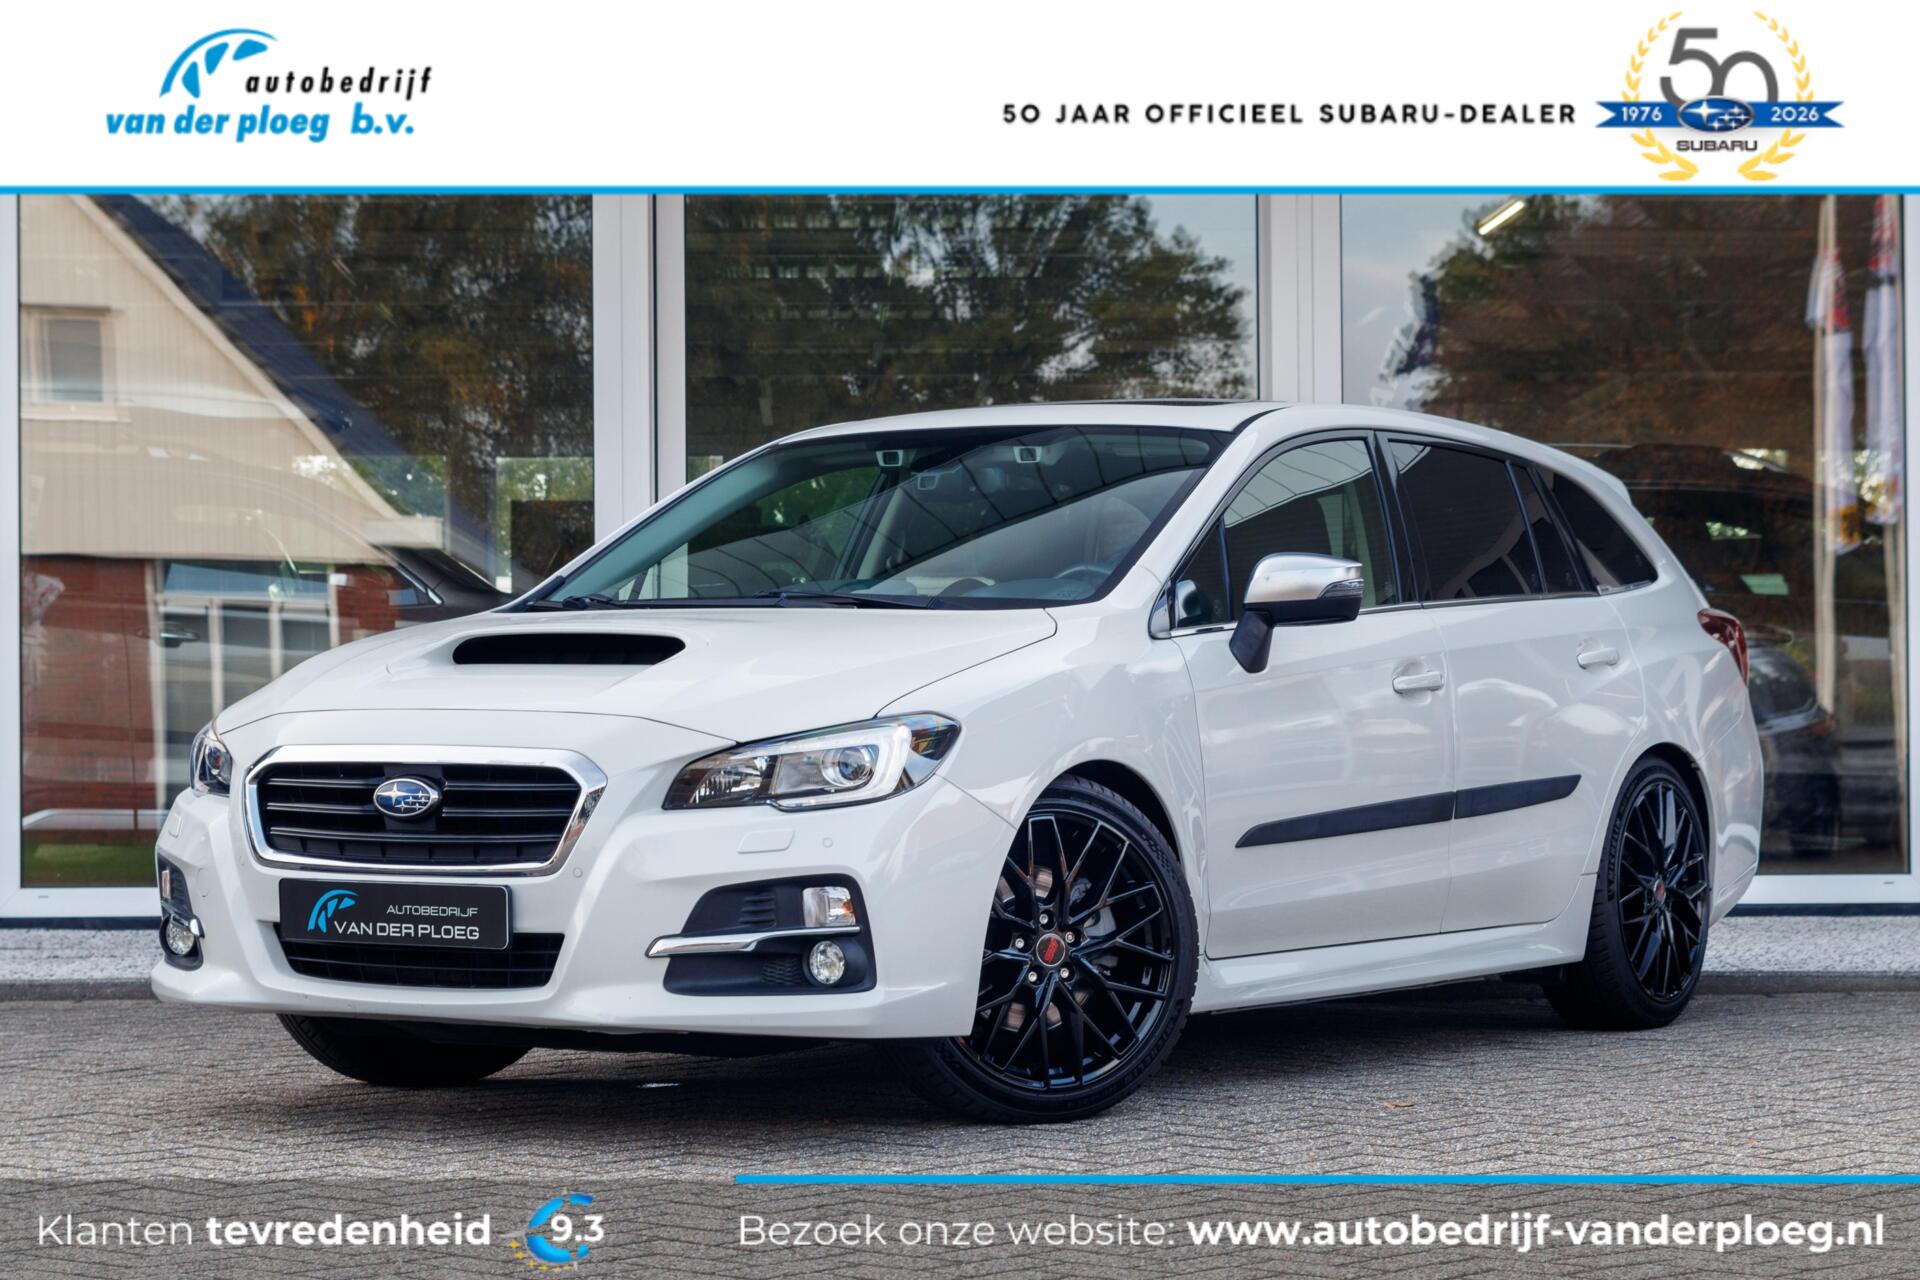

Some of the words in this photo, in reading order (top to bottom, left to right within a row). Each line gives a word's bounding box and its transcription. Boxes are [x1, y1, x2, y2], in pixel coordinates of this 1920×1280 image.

[386, 904, 479, 917] AUTOBEDRIJF
[333, 921, 374, 936] VAN
[376, 922, 415, 938] DER
[418, 924, 480, 940] PLOEG
